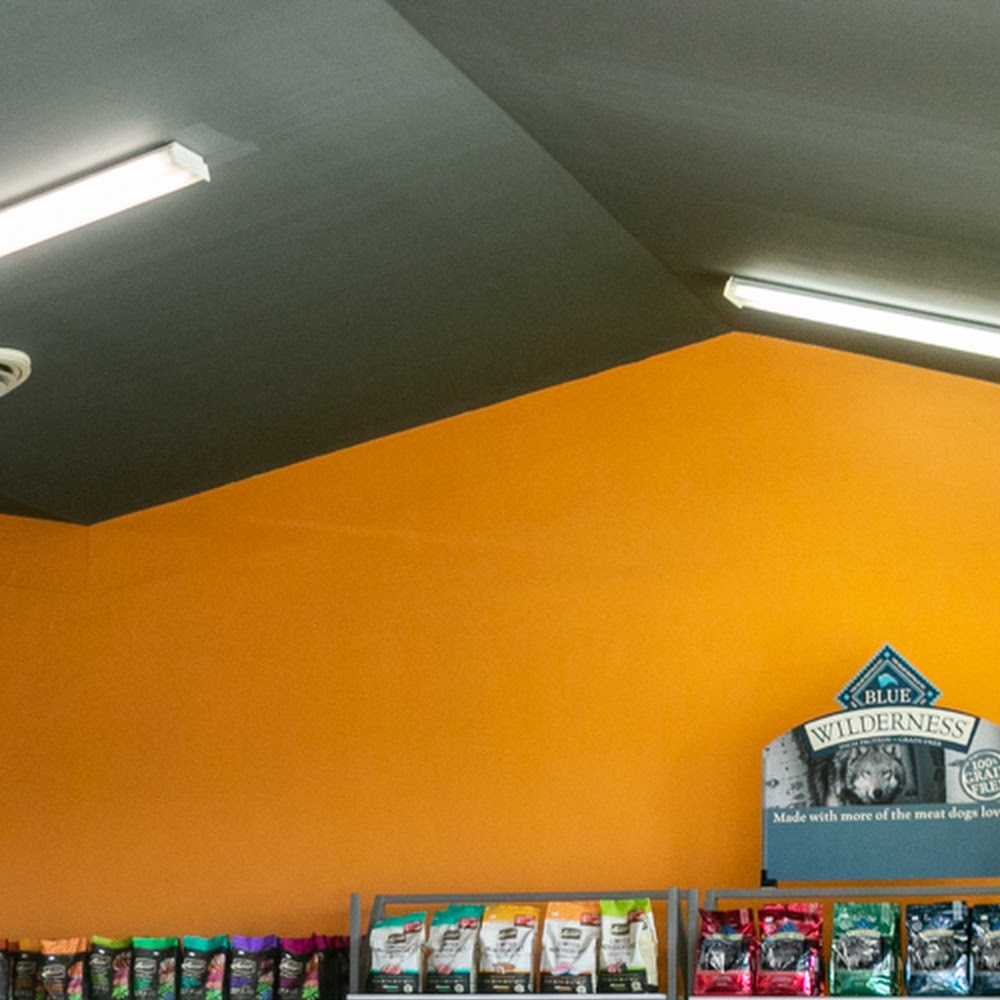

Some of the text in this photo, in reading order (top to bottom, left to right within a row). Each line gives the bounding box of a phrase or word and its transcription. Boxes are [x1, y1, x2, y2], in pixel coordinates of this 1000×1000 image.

[864, 688, 912, 704] BLUE
[810, 712, 968, 744] WILDERNESS
[965, 766, 1000, 783] GRAI
[970, 780, 1000, 795] FRE
[772, 805, 1000, 823] Made with more of the meat dogs lov
